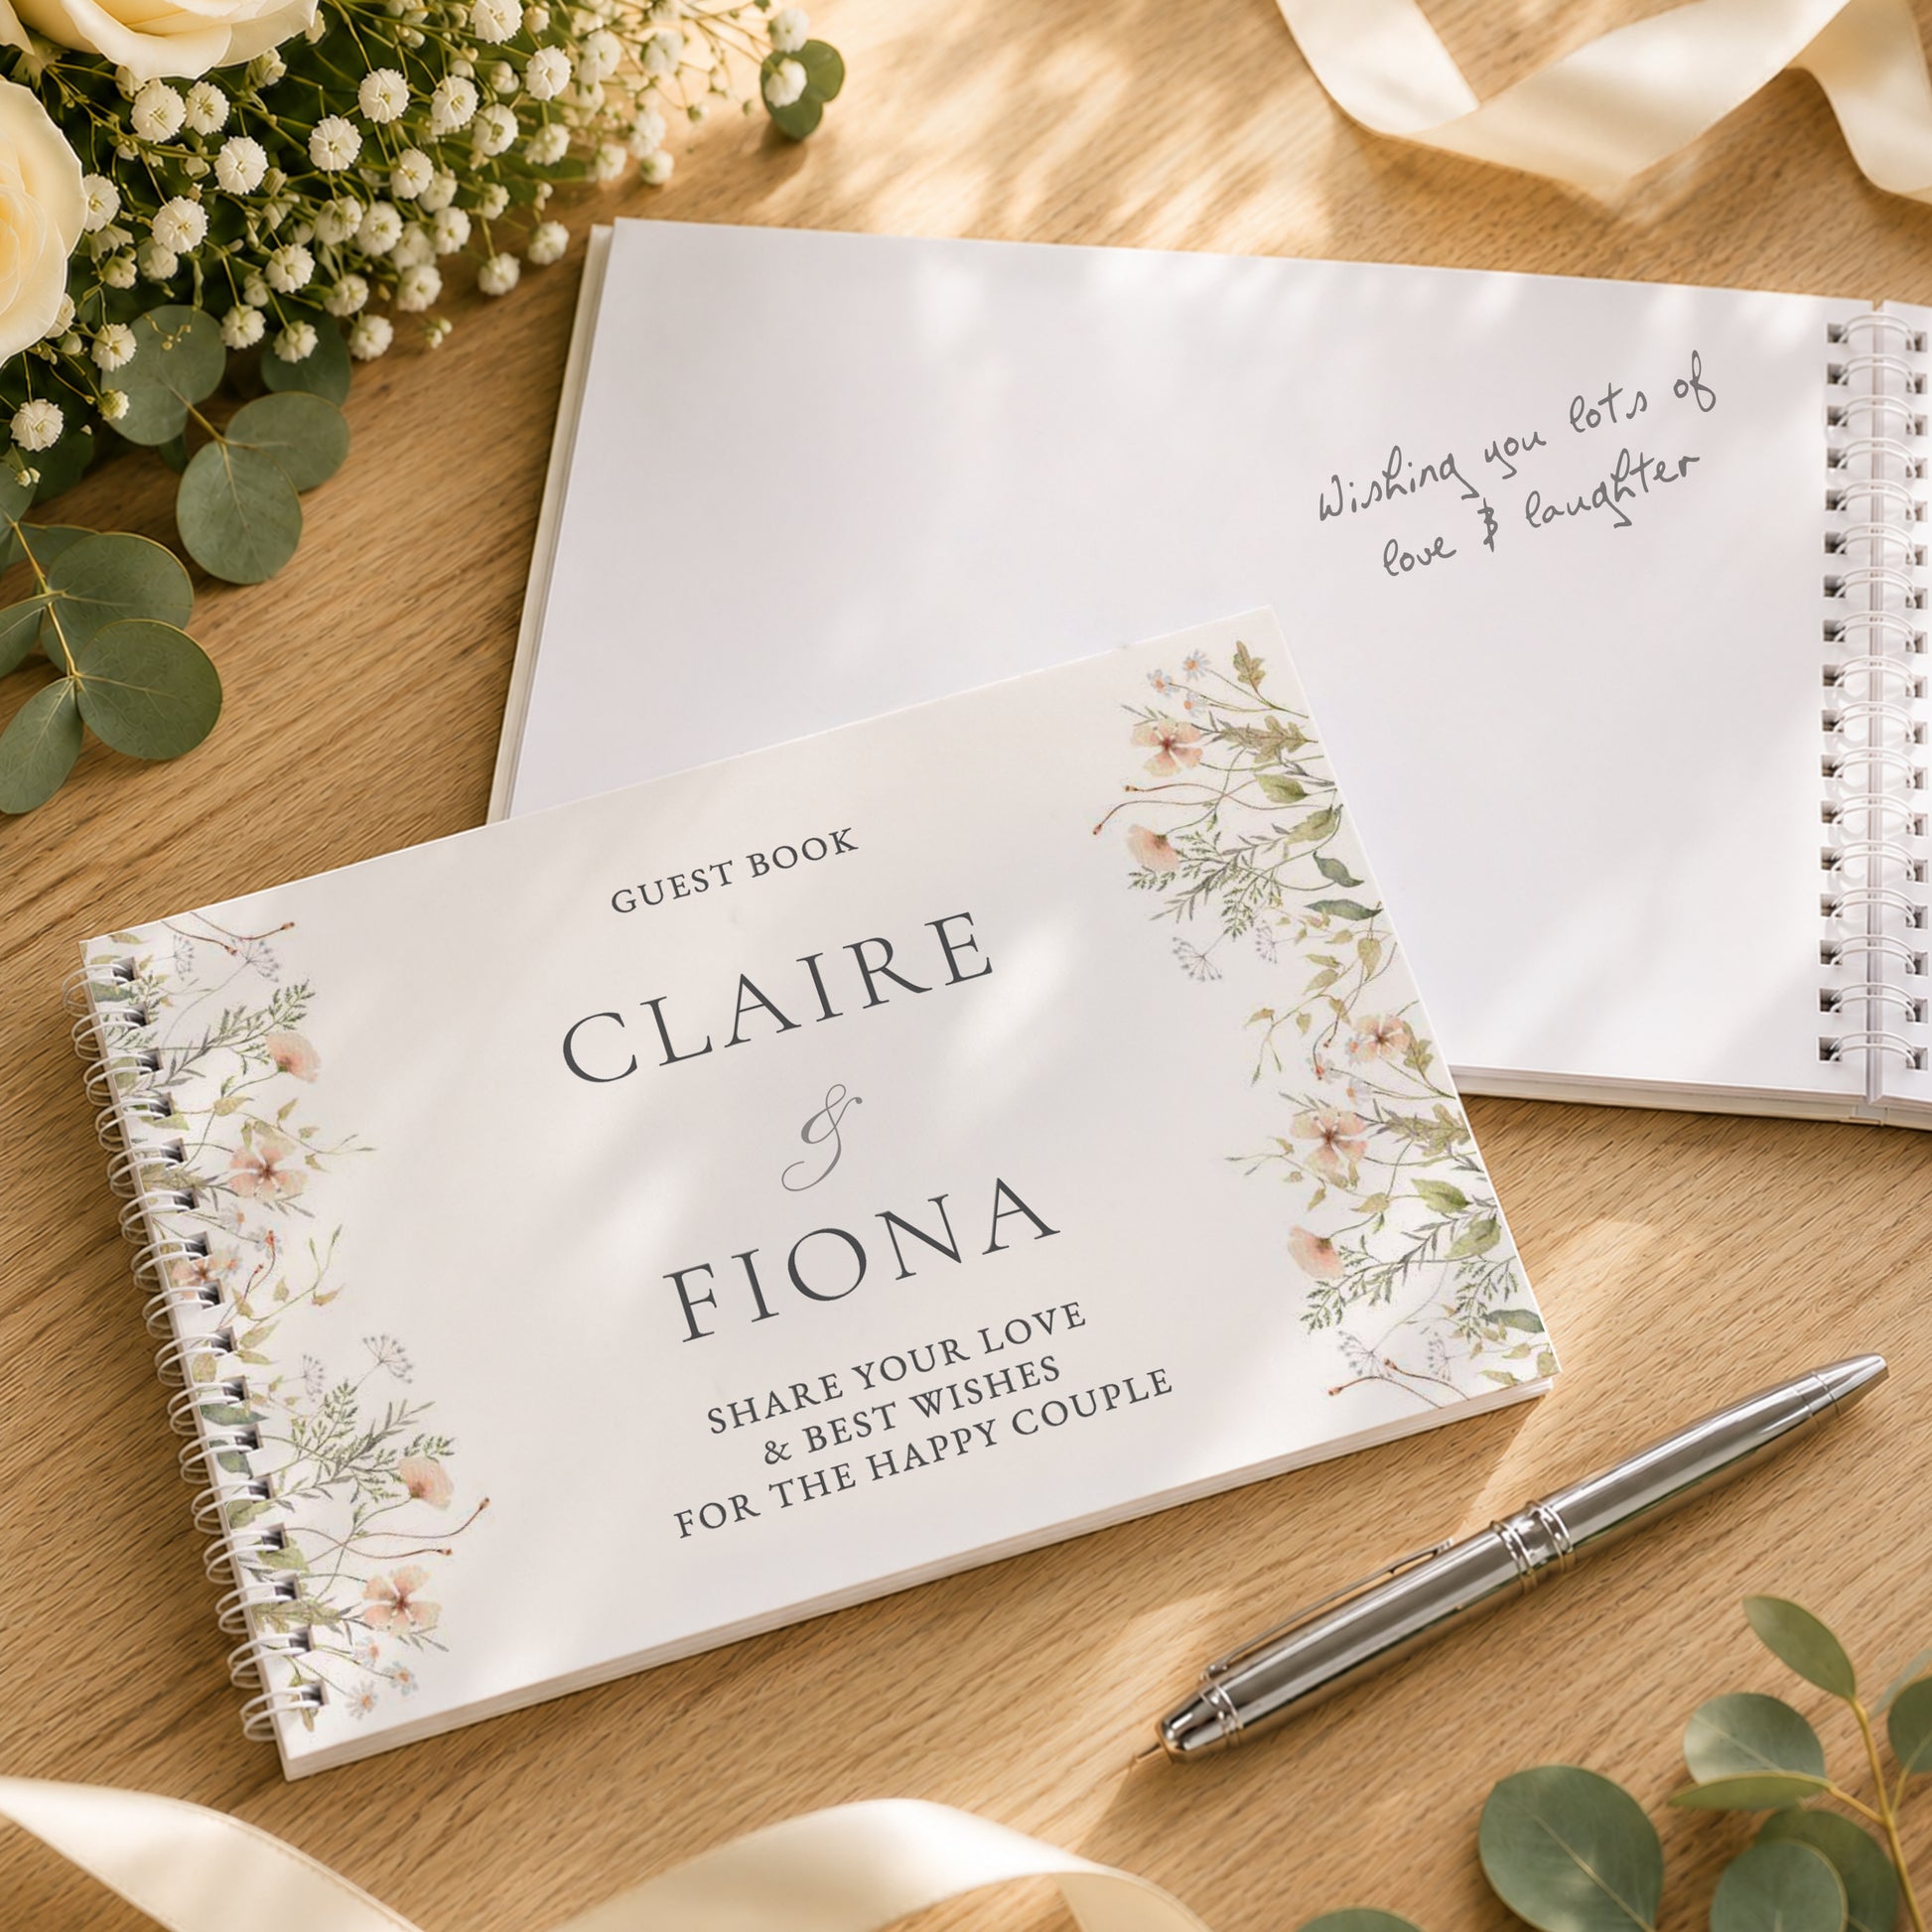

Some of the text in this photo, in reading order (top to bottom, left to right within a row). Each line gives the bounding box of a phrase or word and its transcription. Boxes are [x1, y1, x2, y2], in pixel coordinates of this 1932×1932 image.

[1318, 348, 1717, 522] Wishing you lots of
[1382, 536, 1457, 577] love
[1525, 447, 1701, 529] laughter
[611, 826, 860, 914] GUEST BOOK
[562, 911, 994, 1084] CLAIRE
[780, 1083, 864, 1192] &
[661, 1176, 1061, 1343] FIONA
[707, 1301, 1086, 1435] SHARE YOUR LOVE
[763, 1354, 1060, 1465] & BEST WISHES
[672, 1367, 1173, 1540] FOR THE HAPPY COUPLE
